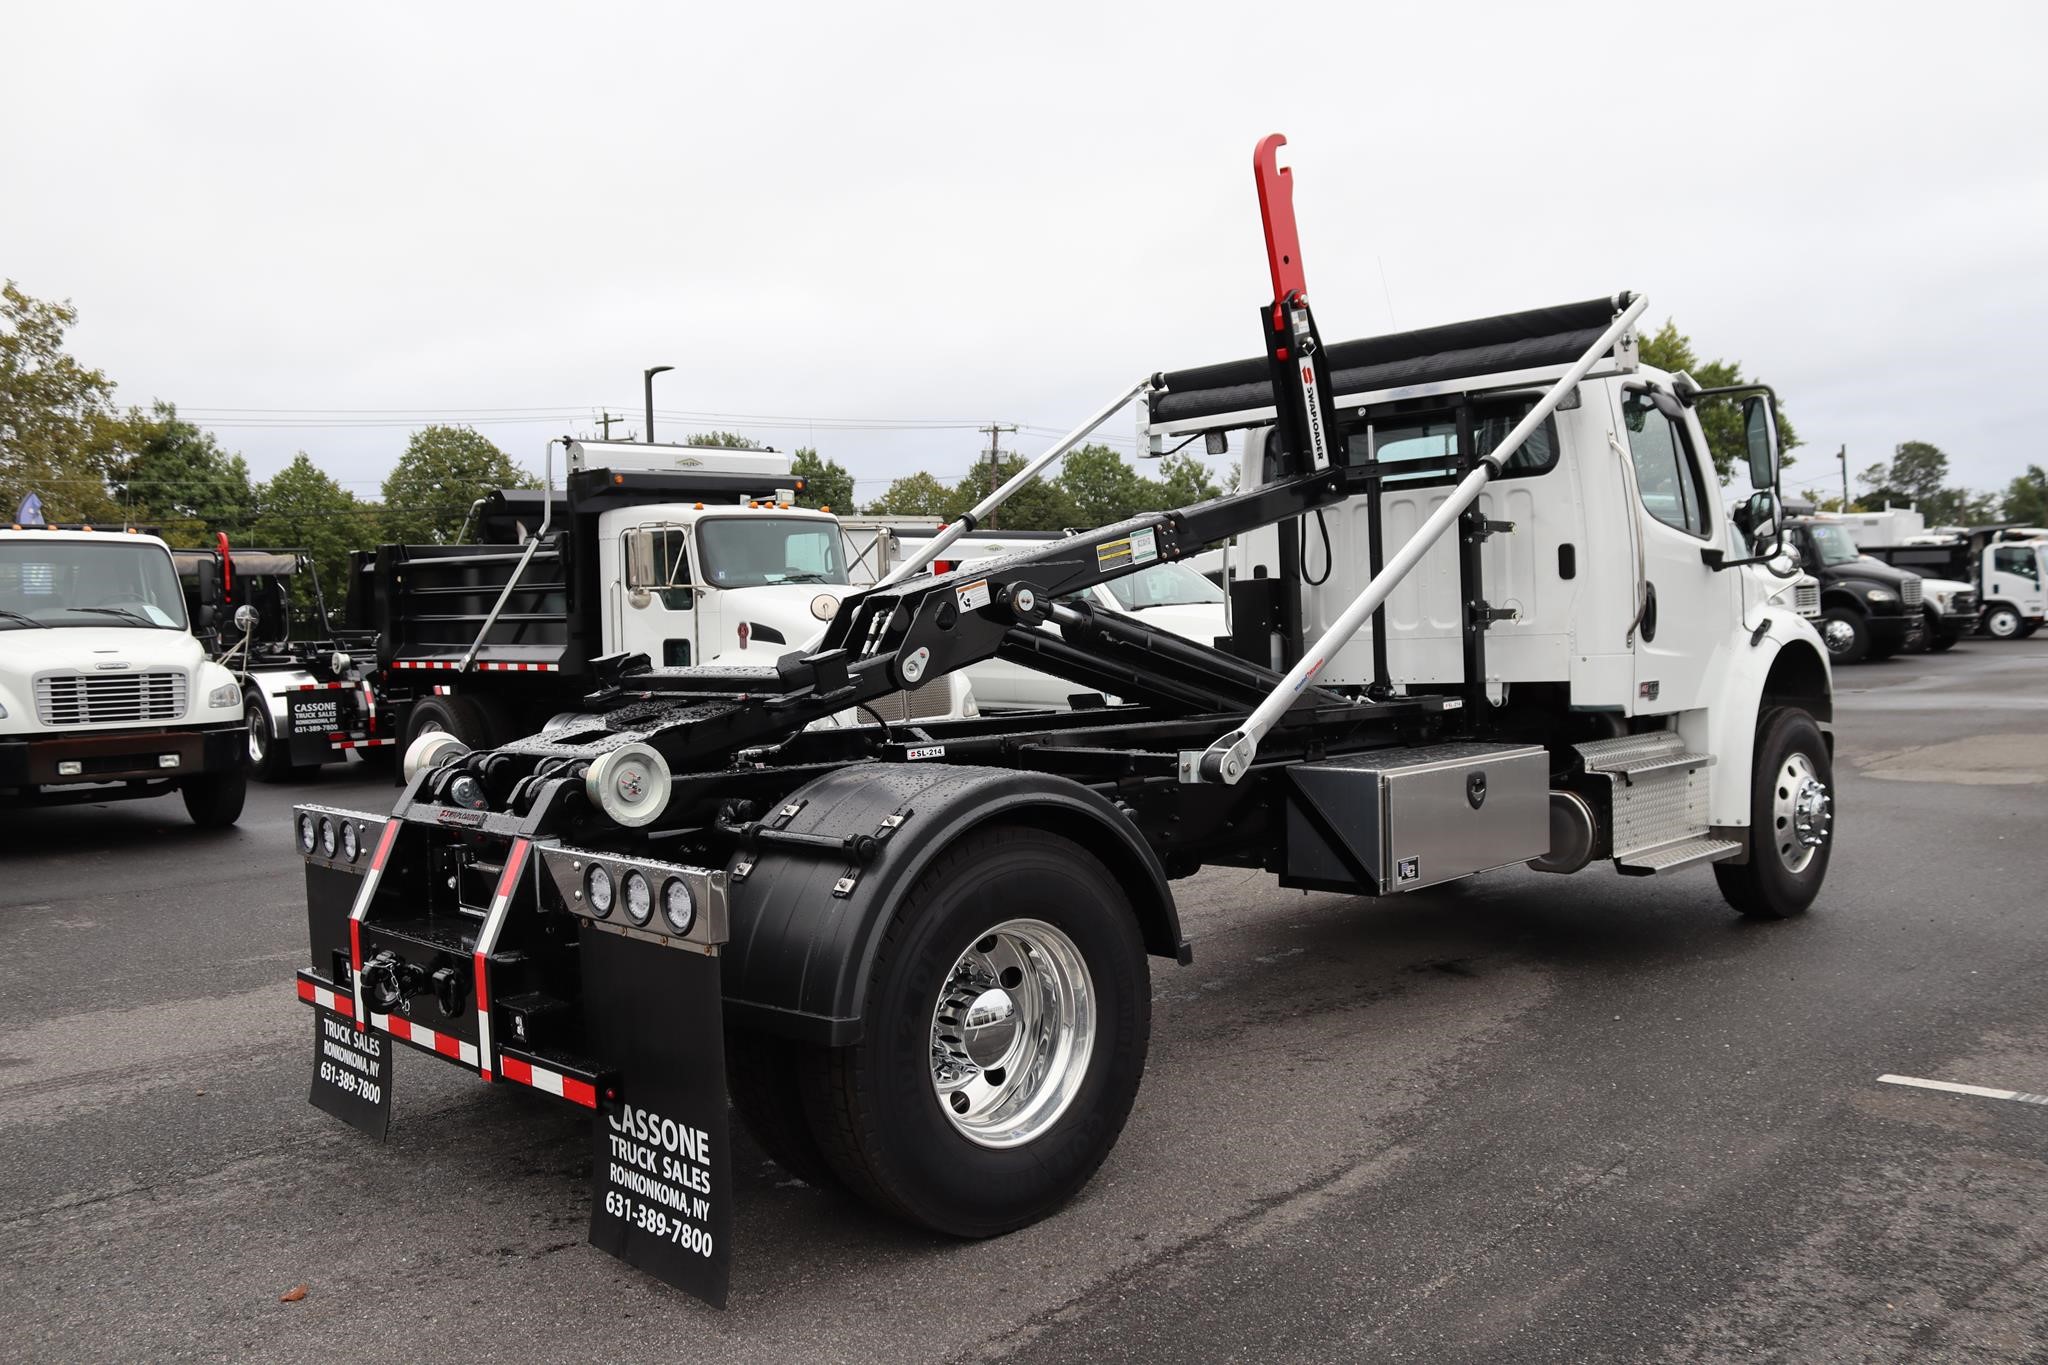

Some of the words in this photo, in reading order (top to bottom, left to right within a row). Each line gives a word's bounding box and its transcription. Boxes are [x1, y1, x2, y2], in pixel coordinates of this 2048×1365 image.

[1307, 387, 1323, 459] SWAPLOADER
[294, 702, 336, 712] CASSONE
[916, 749, 942, 757] SL-214
[323, 1018, 351, 1045] TRUCK
[353, 1031, 380, 1057] SALES
[323, 1040, 369, 1076] RONKONKOMA,
[369, 1060, 380, 1078] NY
[320, 1061, 380, 1104] 631-389-7800
[609, 1134, 657, 1174] TRUCK
[663, 1156, 711, 1194] SALES
[610, 1162, 691, 1217] RONKONKOMA,
[693, 1197, 710, 1222] NY
[605, 1191, 713, 1257] 631-389-7800
